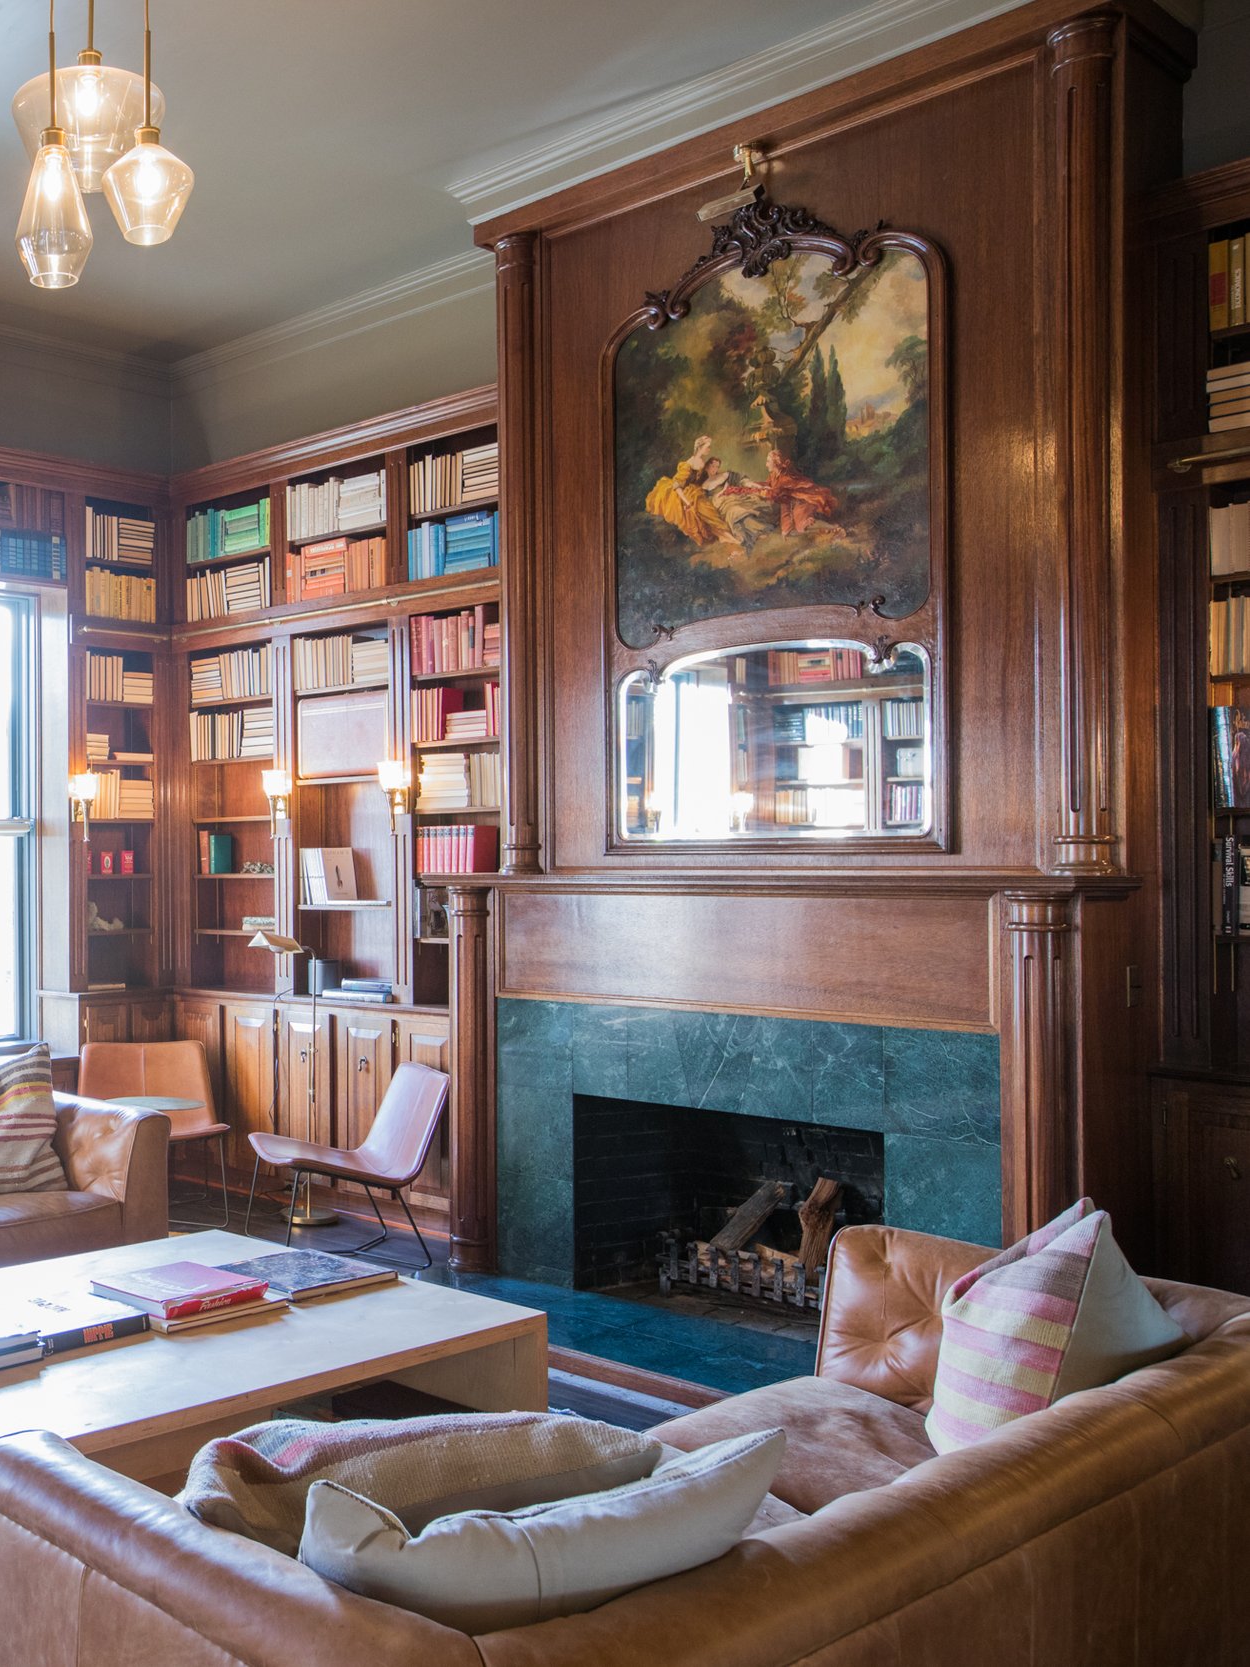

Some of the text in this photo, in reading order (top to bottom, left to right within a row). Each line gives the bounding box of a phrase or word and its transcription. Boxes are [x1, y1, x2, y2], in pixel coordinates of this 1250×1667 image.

[1225, 837, 1234, 887] Survival Skills
[198, 1297, 232, 1311] Fashion
[82, 1323, 114, 1343] HIPPIE
